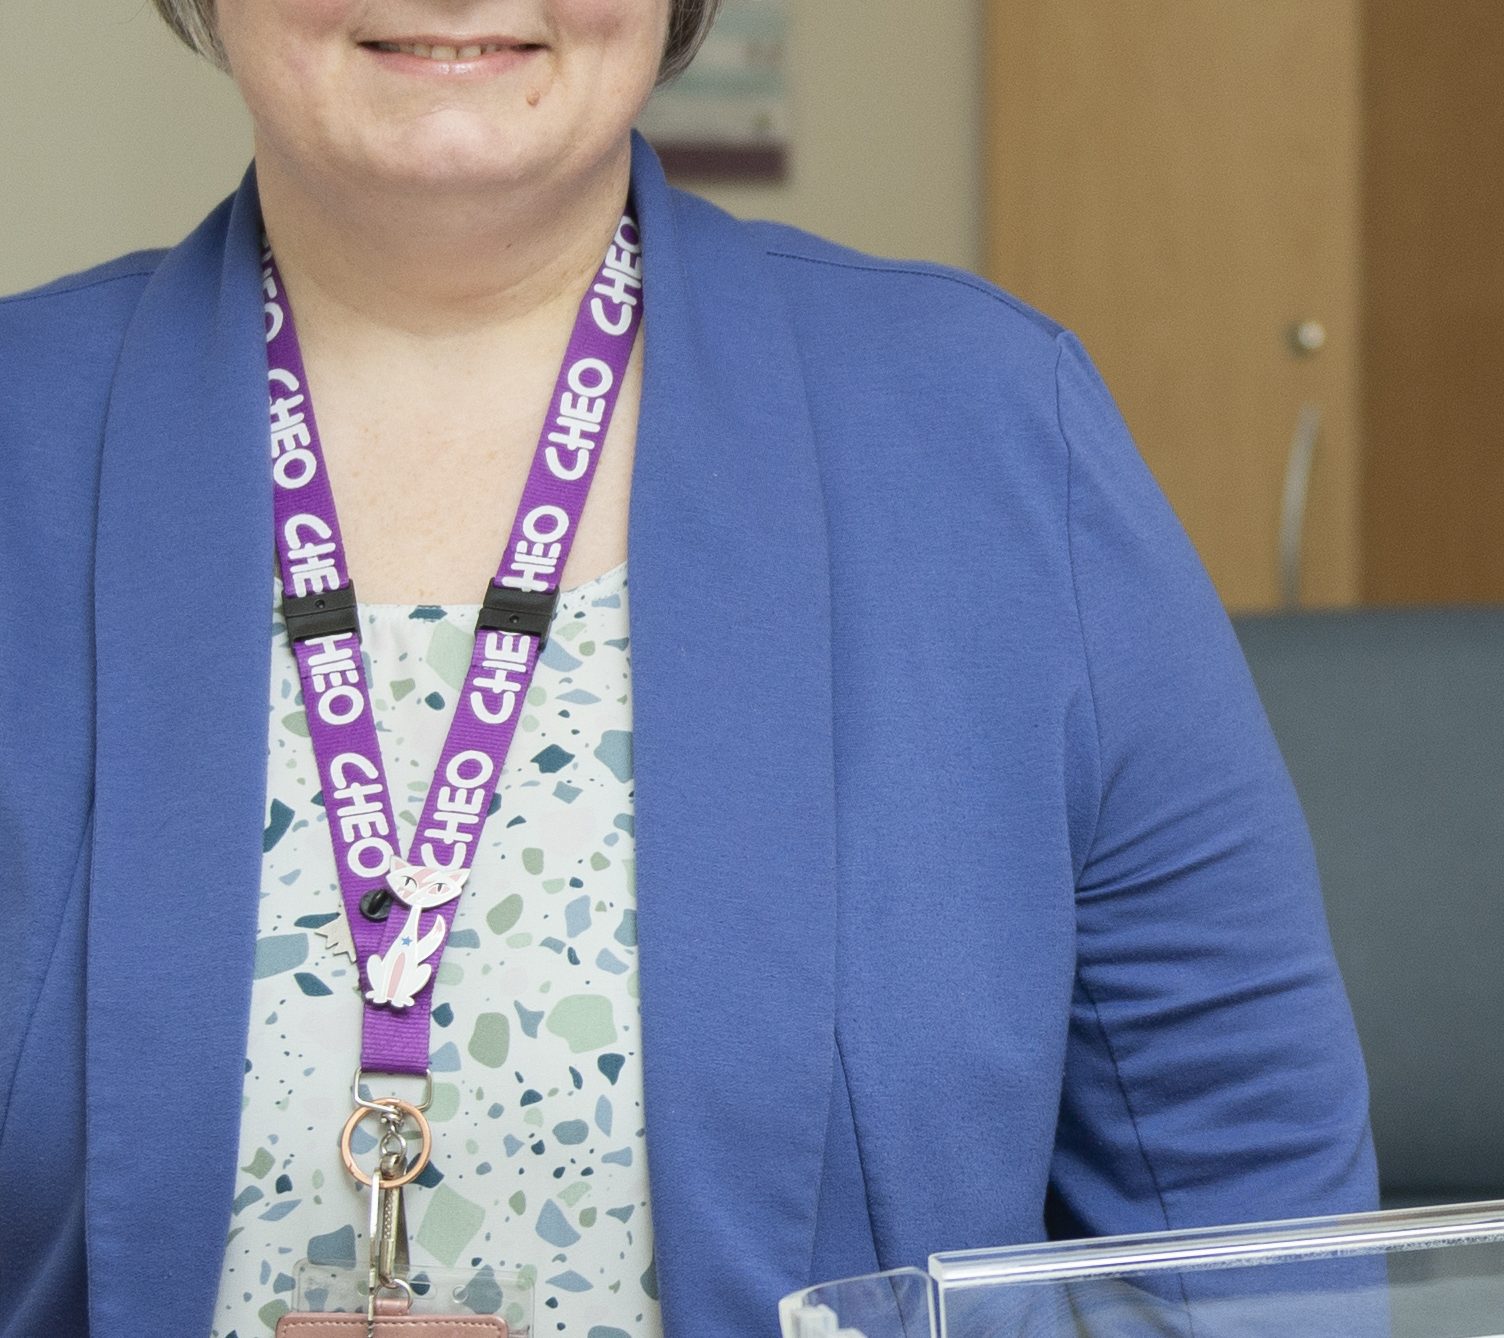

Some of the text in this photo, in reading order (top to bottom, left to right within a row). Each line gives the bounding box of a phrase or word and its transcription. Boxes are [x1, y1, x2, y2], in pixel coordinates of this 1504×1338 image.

[590, 214, 644, 337] CHEO
[267, 368, 318, 490] CHEO
[544, 357, 614, 481] CHEO
[329, 752, 395, 879] CHEO
[420, 749, 494, 873] CHEO
